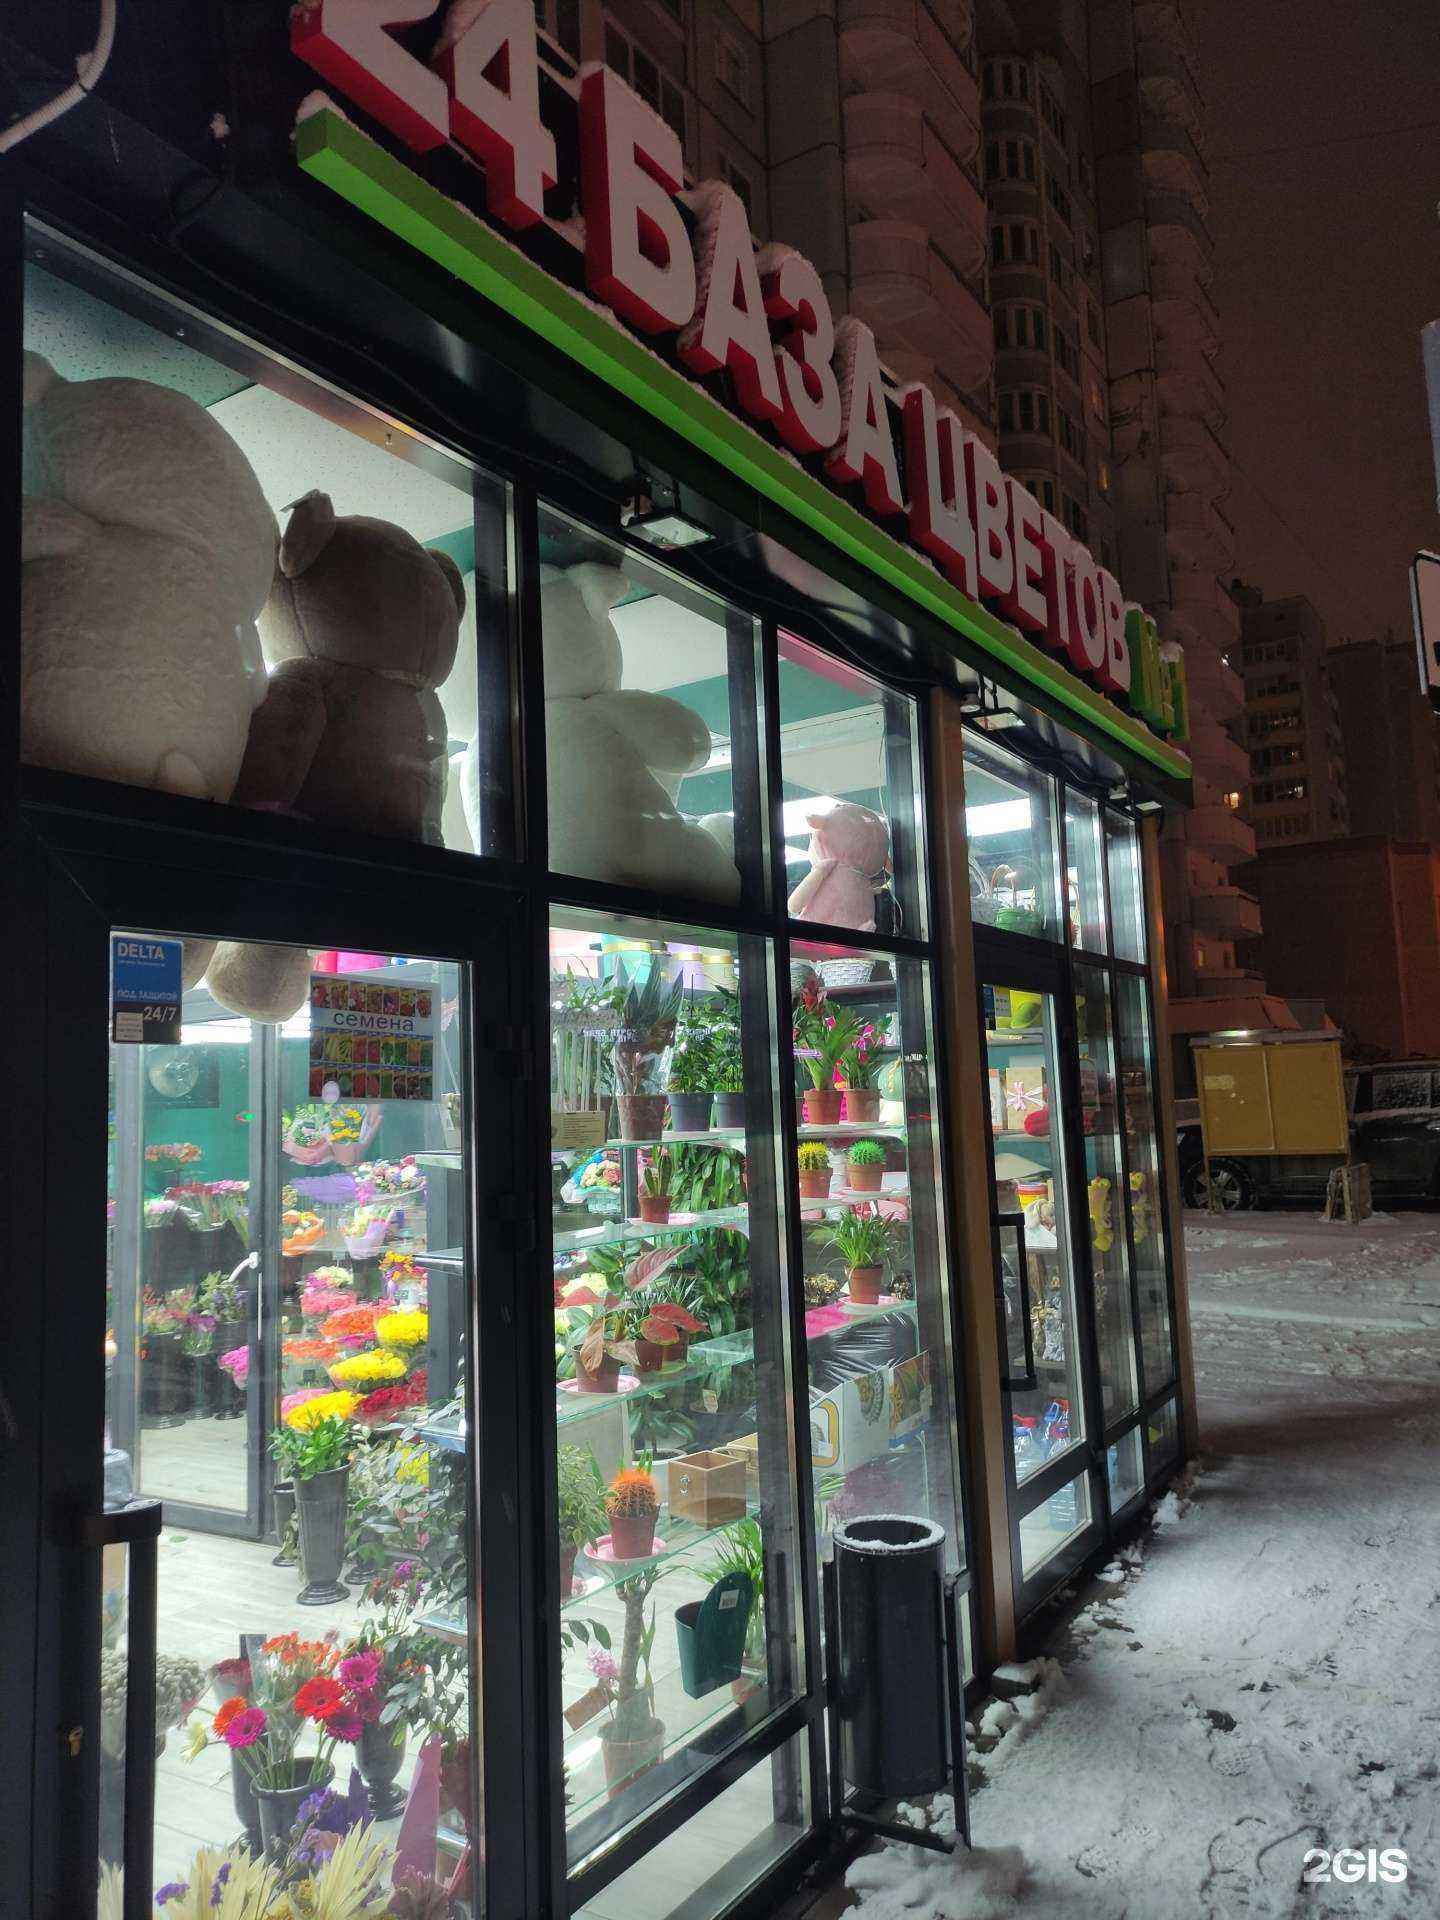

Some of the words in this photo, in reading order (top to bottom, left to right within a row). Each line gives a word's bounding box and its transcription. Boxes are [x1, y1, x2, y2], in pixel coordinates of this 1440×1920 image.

[590, 64, 905, 512] БАЗА
[912, 383, 1133, 694] ЦВЕТОВ
[117, 942, 166, 961] DELTA
[143, 1005, 177, 1022] 24/7
[333, 1012, 414, 1032] семена
